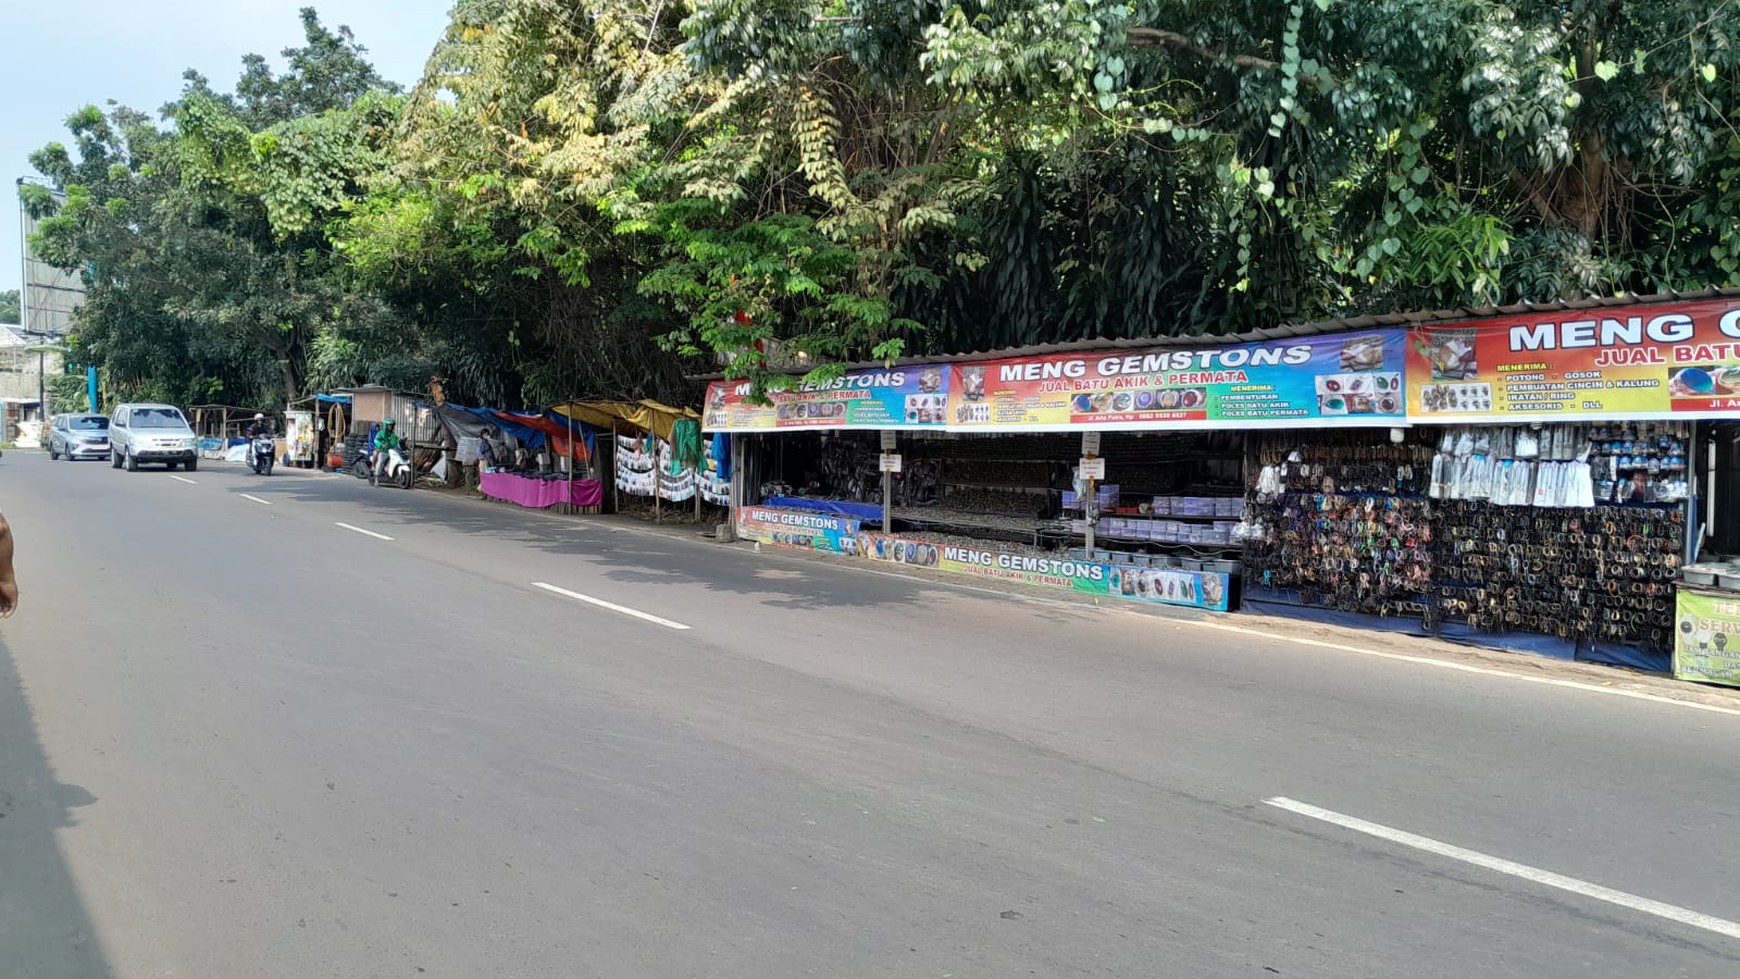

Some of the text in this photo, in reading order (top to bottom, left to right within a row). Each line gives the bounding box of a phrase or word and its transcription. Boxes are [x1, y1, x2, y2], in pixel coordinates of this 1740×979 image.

[1509, 313, 1695, 351] MENG
[1594, 346, 1667, 366] JUAL
[1000, 344, 1313, 382] MENG GEMSTONS
[1496, 363, 1547, 372] MENERIMA
[1038, 370, 1248, 393] JUAL BATU AKIK & PERMATA
[1505, 371, 1602, 382] POTONG GOSOK
[1506, 382, 1565, 392] PEMBUATAN
[1615, 379, 1659, 388] KALUNG
[828, 390, 871, 399] PERMATA
[1507, 393, 1543, 401] IKATAN
[1549, 392, 1575, 400] RING
[1508, 401, 1603, 411] AKSESORIS DLL
[752, 510, 778, 522] MENG
[781, 514, 838, 530] GEMSTONS
[944, 547, 1103, 580] MENG GEMSTONS
[1034, 575, 1073, 587] PERMATA
